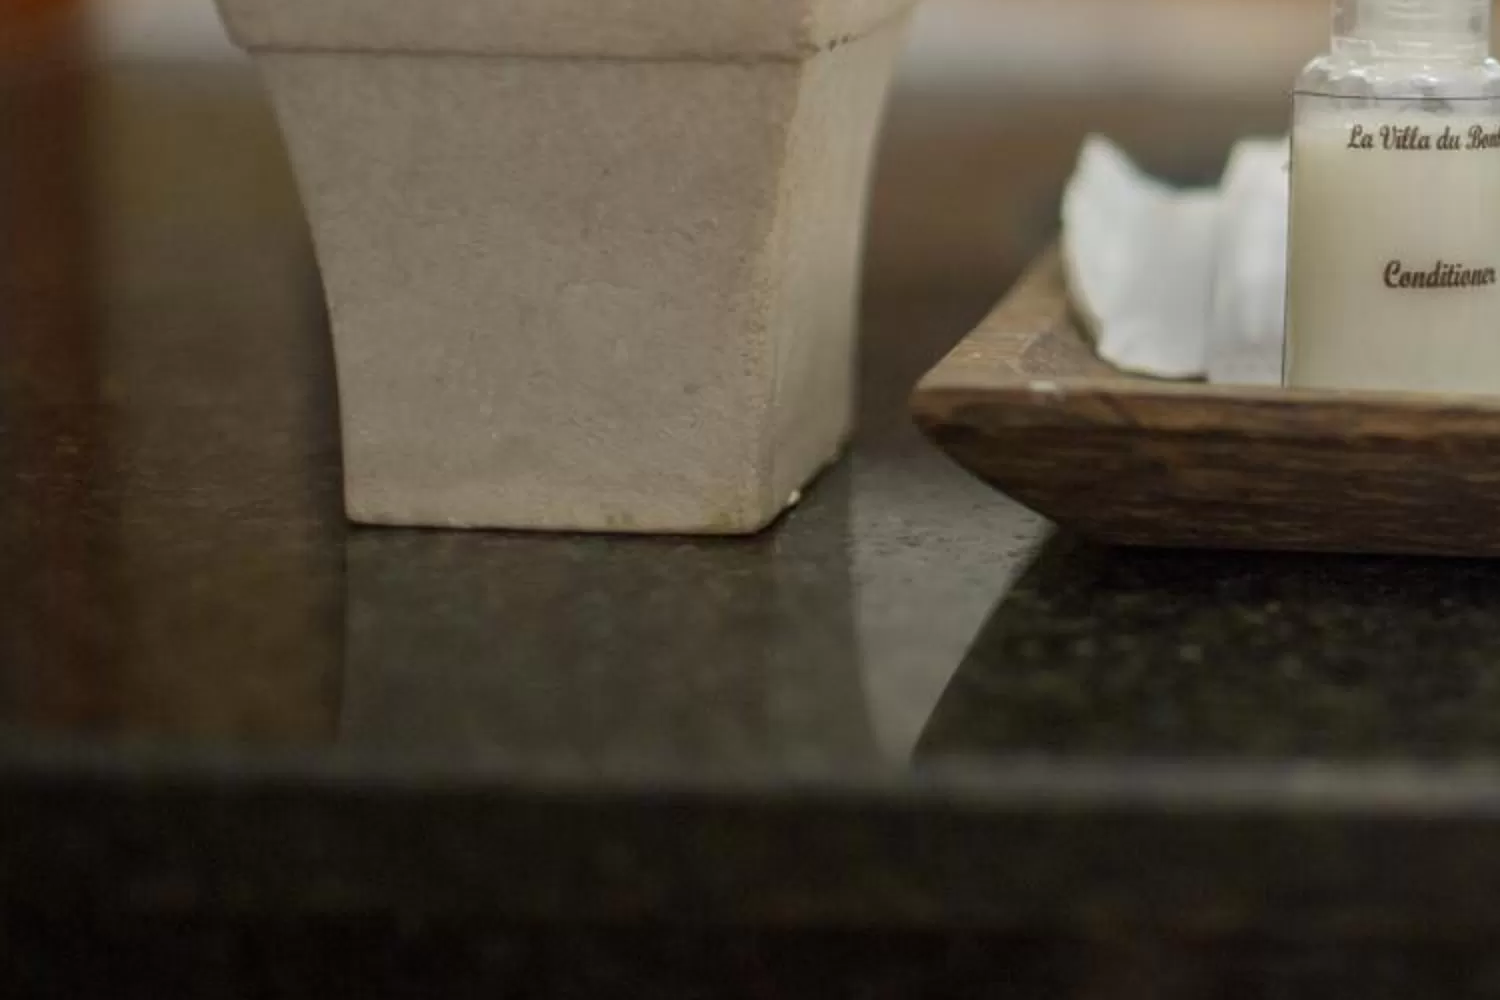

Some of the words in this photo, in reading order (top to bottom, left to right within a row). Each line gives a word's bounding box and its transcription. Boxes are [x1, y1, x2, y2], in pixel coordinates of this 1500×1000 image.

[1347, 124, 1374, 150] La
[1379, 125, 1432, 150] Villa
[1436, 126, 1461, 150] du
[1383, 260, 1497, 288] Conditioner
